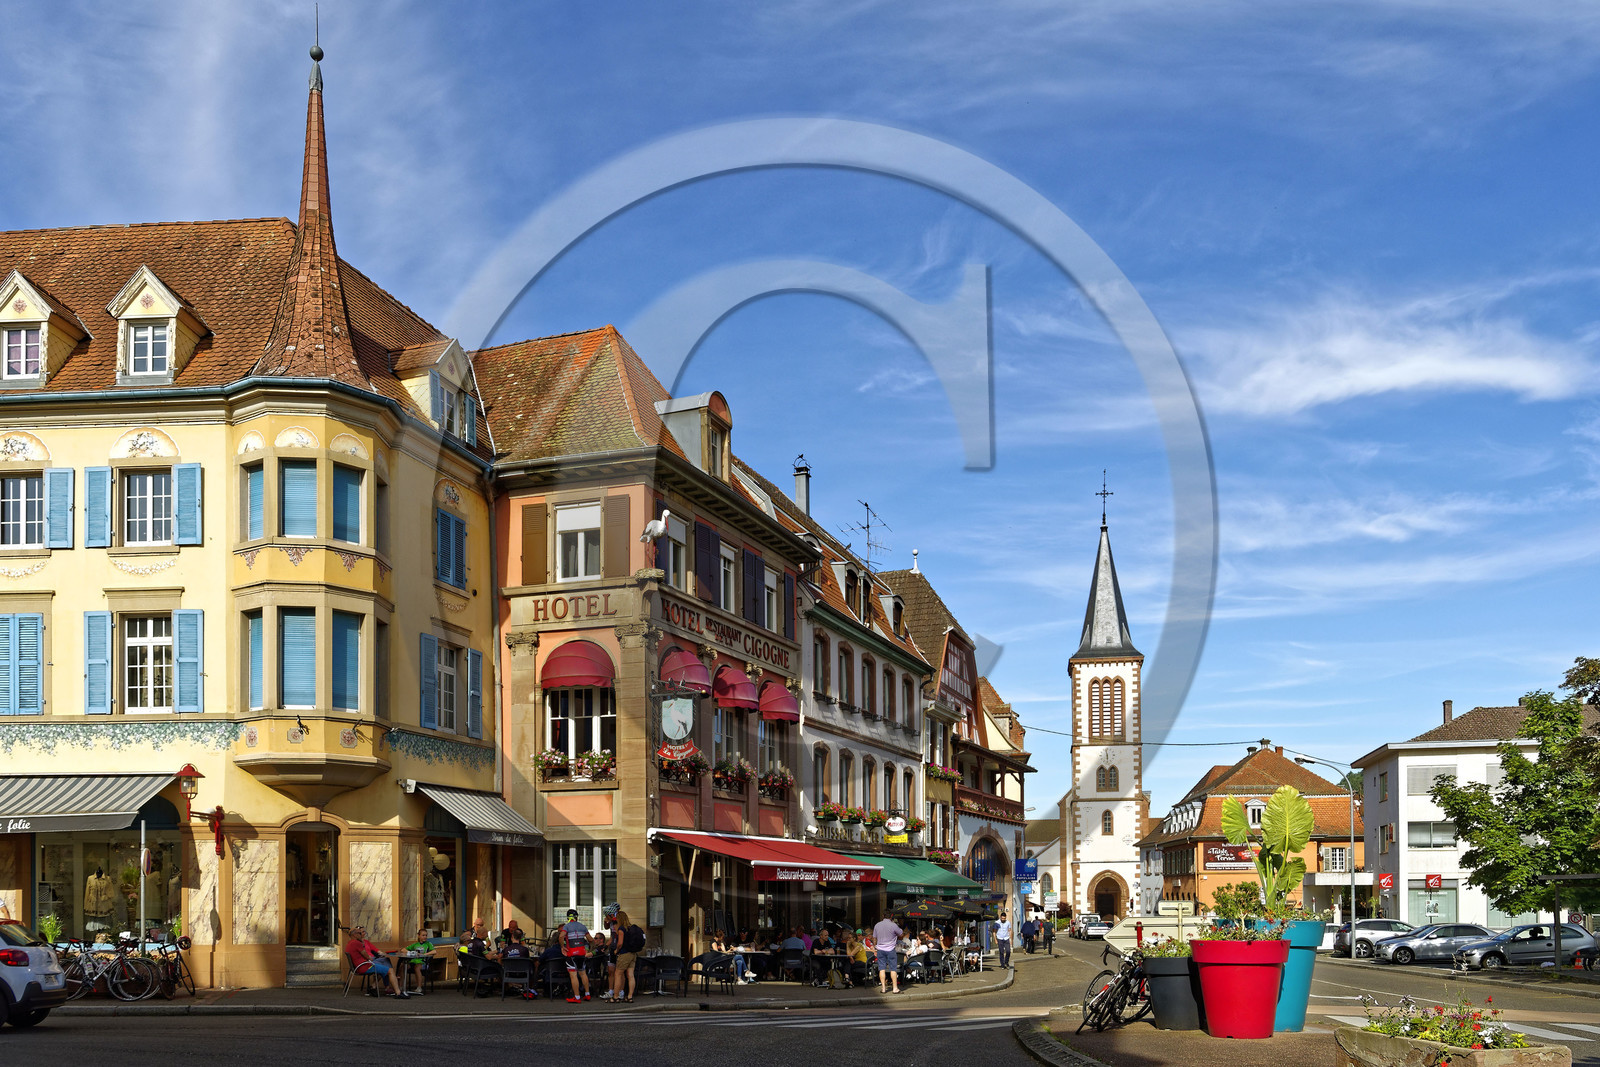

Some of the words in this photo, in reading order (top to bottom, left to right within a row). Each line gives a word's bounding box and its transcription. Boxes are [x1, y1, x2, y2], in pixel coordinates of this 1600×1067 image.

[532, 593, 618, 621] HOTEL
[661, 597, 704, 635] HOTEL
[705, 616, 742, 643] RESTAURANT
[743, 633, 790, 669] CIGOGNE
[7, 819, 31, 833] folie
